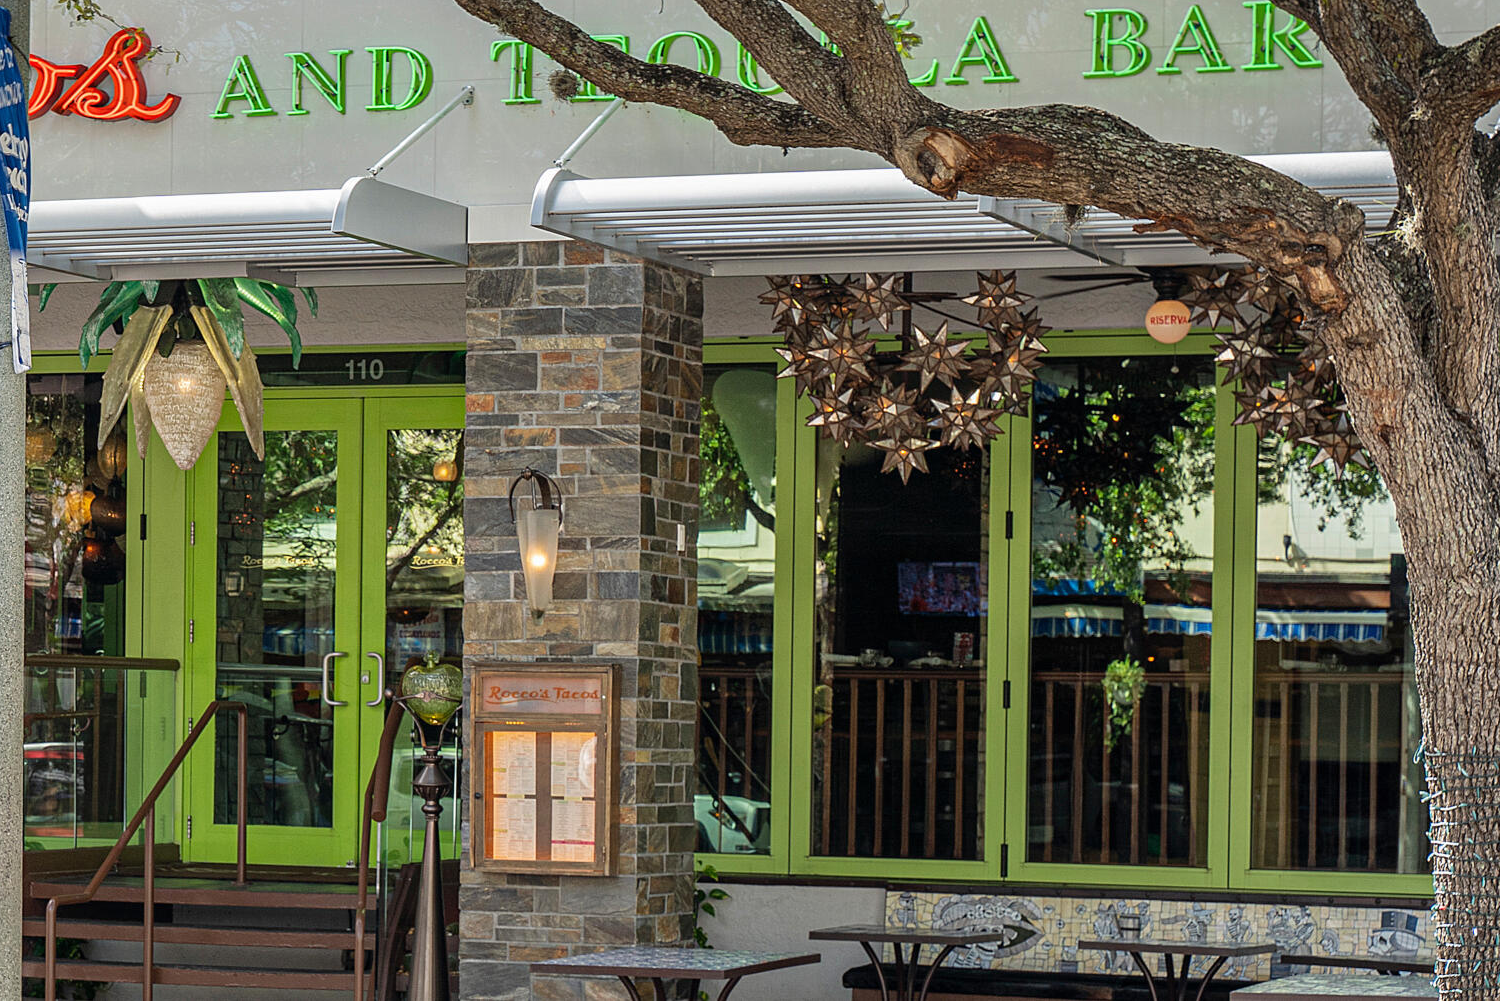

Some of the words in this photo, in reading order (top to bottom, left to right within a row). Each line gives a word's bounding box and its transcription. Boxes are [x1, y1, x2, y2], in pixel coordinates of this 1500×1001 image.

[209, 46, 435, 119] AND
[490, 15, 1020, 105] TQULA
[1082, 0, 1324, 80] BAR
[345, 358, 384, 380] 110
[411, 555, 452, 566] Rocco's
[488, 686, 549, 700] Rocco's
[552, 687, 600, 702] Tacos
